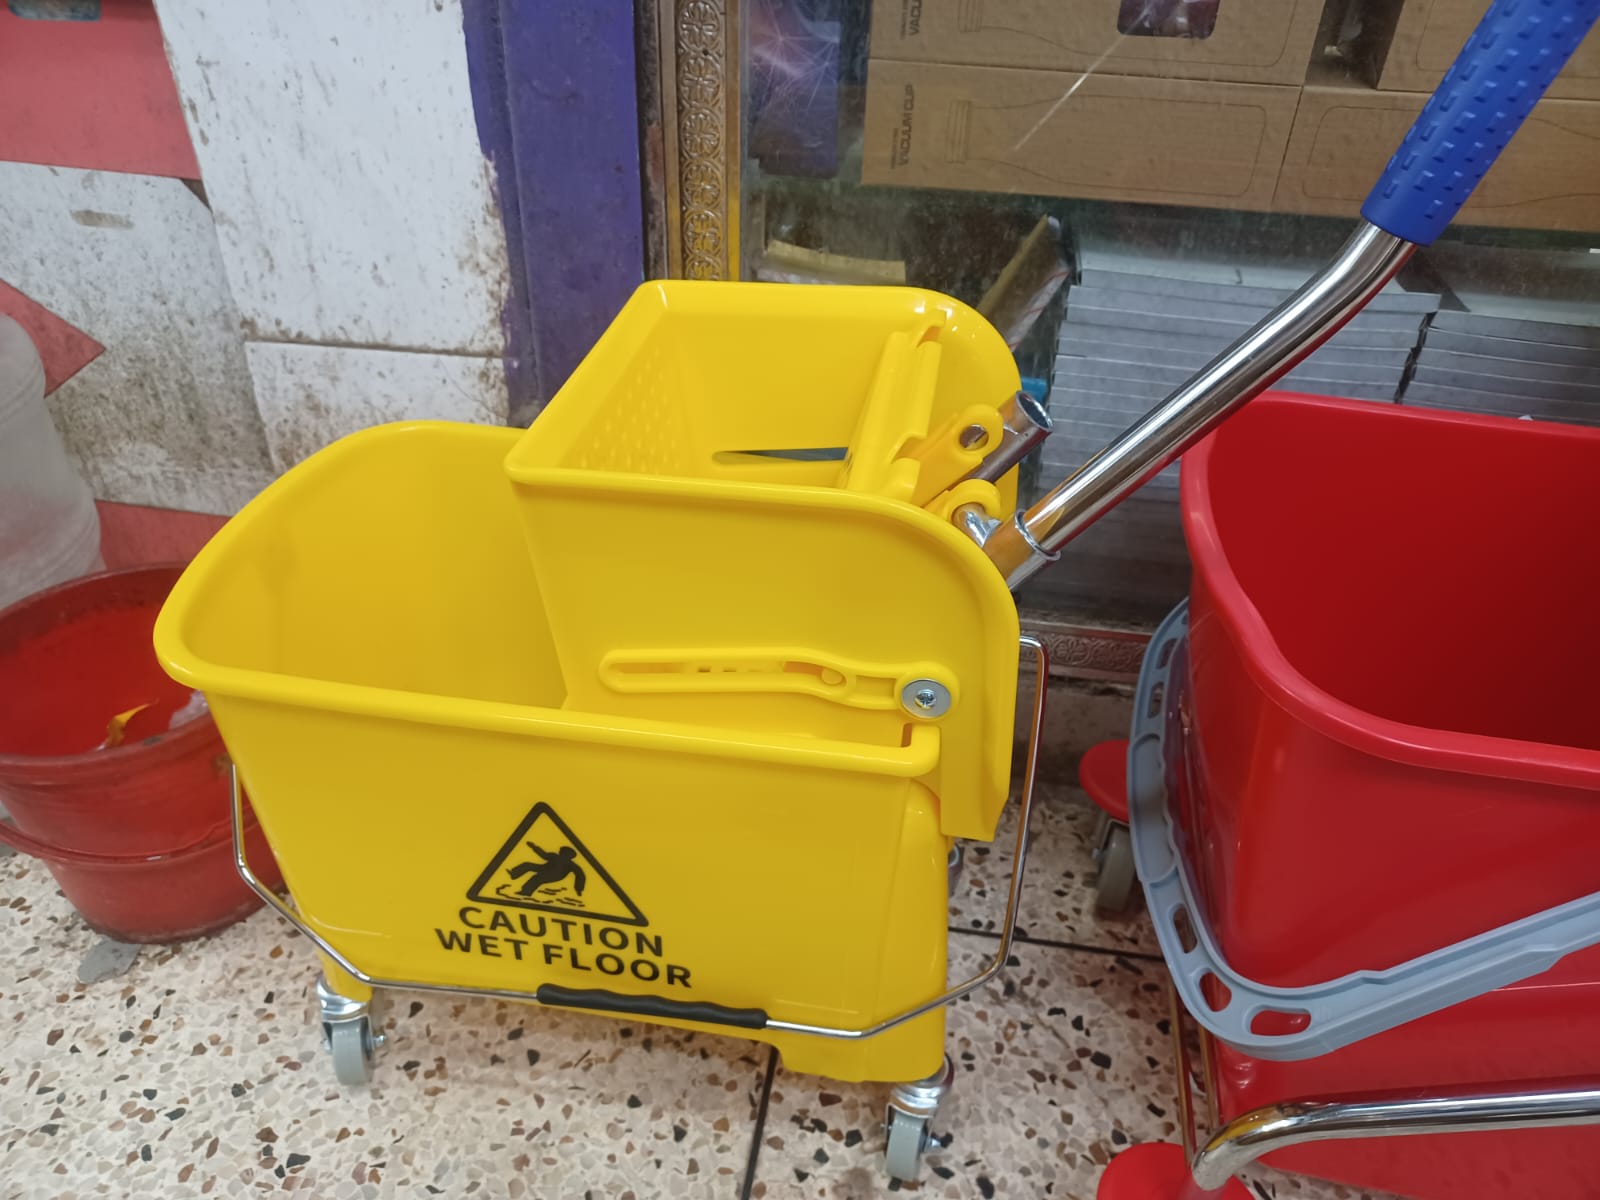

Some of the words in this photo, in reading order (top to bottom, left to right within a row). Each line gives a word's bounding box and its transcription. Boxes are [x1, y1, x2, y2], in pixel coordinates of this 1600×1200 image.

[898, 113, 912, 166] VACUUM
[458, 906, 663, 957] CAUTION
[434, 928, 529, 961] WET
[542, 943, 692, 989] FLOOR
